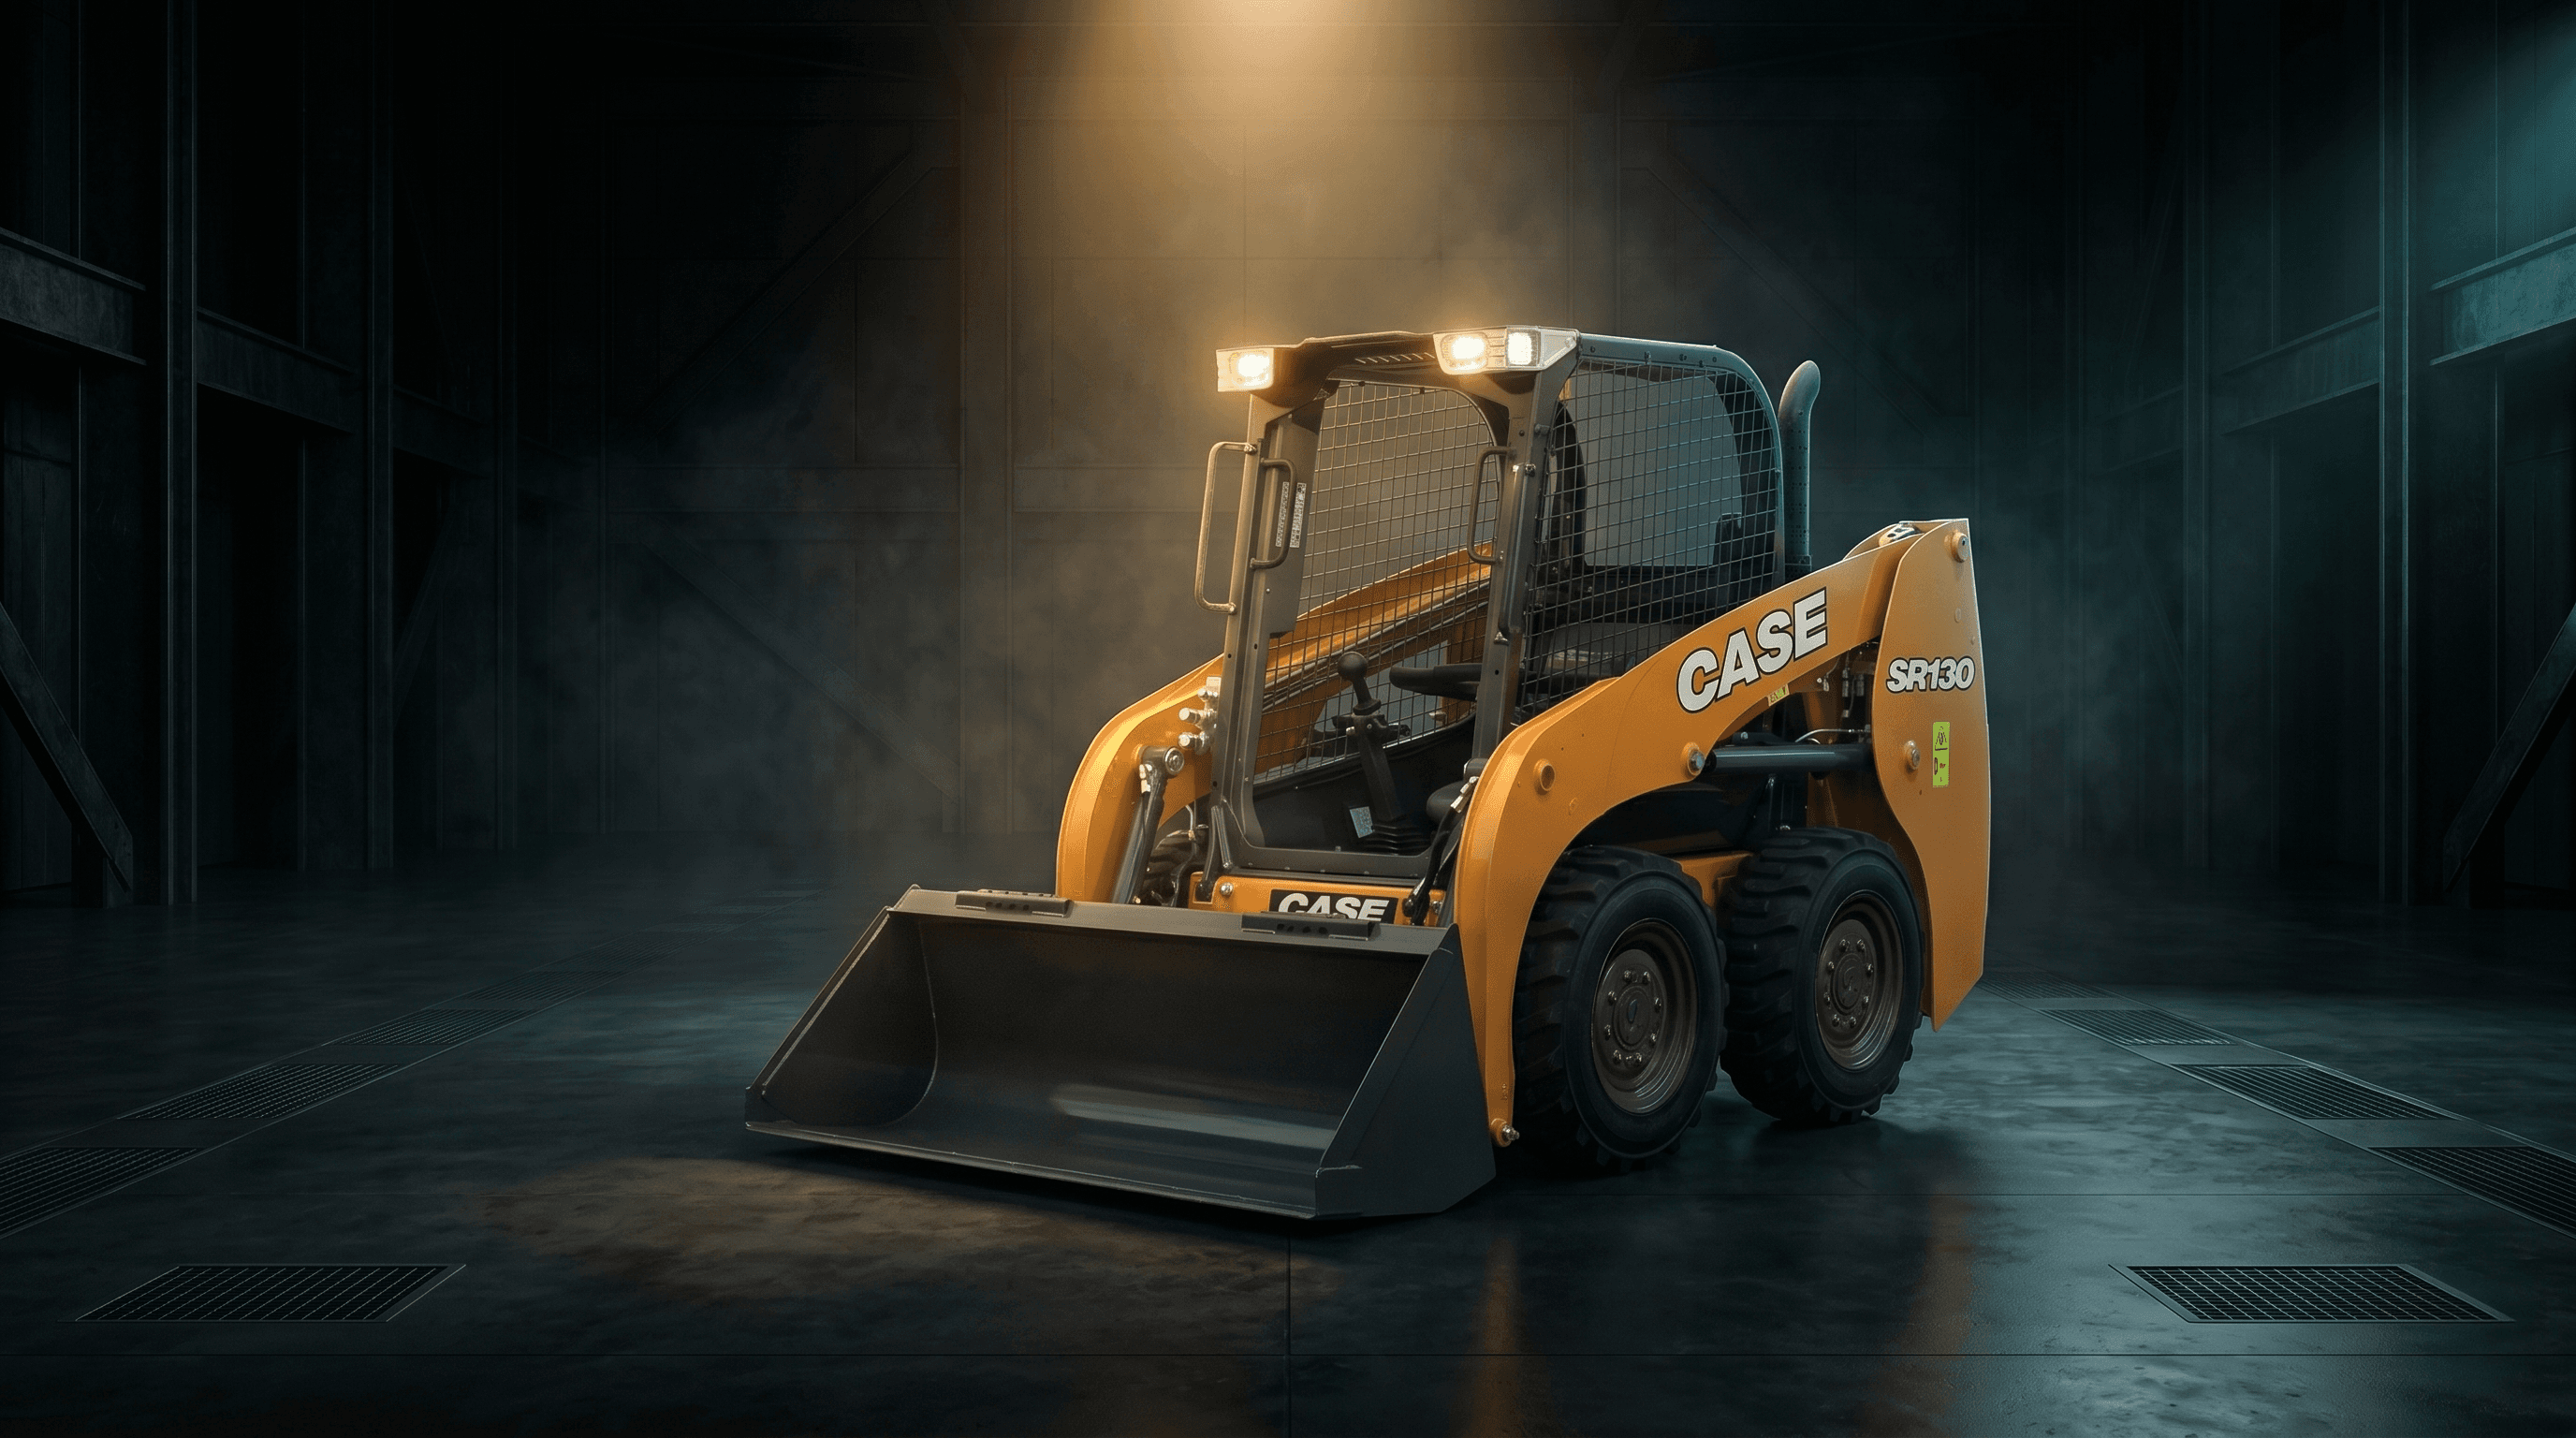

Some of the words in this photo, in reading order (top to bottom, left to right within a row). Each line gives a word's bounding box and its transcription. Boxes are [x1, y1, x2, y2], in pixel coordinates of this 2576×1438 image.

[1676, 587, 1827, 712] CASE
[1885, 656, 1975, 693] SR130
[1278, 892, 1390, 922] CASE
